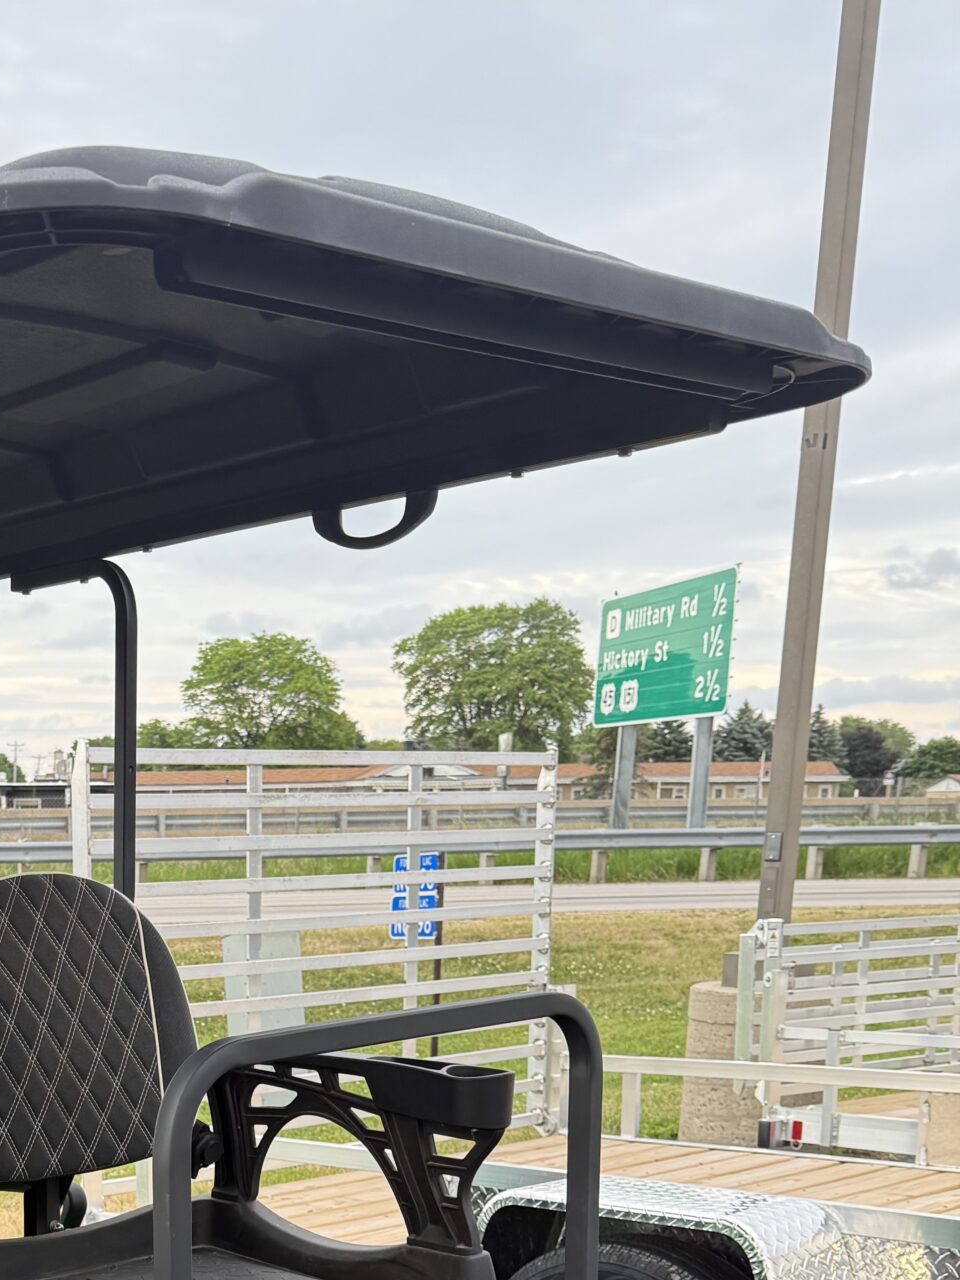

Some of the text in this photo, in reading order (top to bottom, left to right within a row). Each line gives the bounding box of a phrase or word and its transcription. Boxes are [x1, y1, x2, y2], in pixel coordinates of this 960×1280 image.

[624, 603, 675, 631] Military
[680, 594, 699, 618] Rd
[602, 648, 649, 671] Hickory
[653, 640, 669, 662] St
